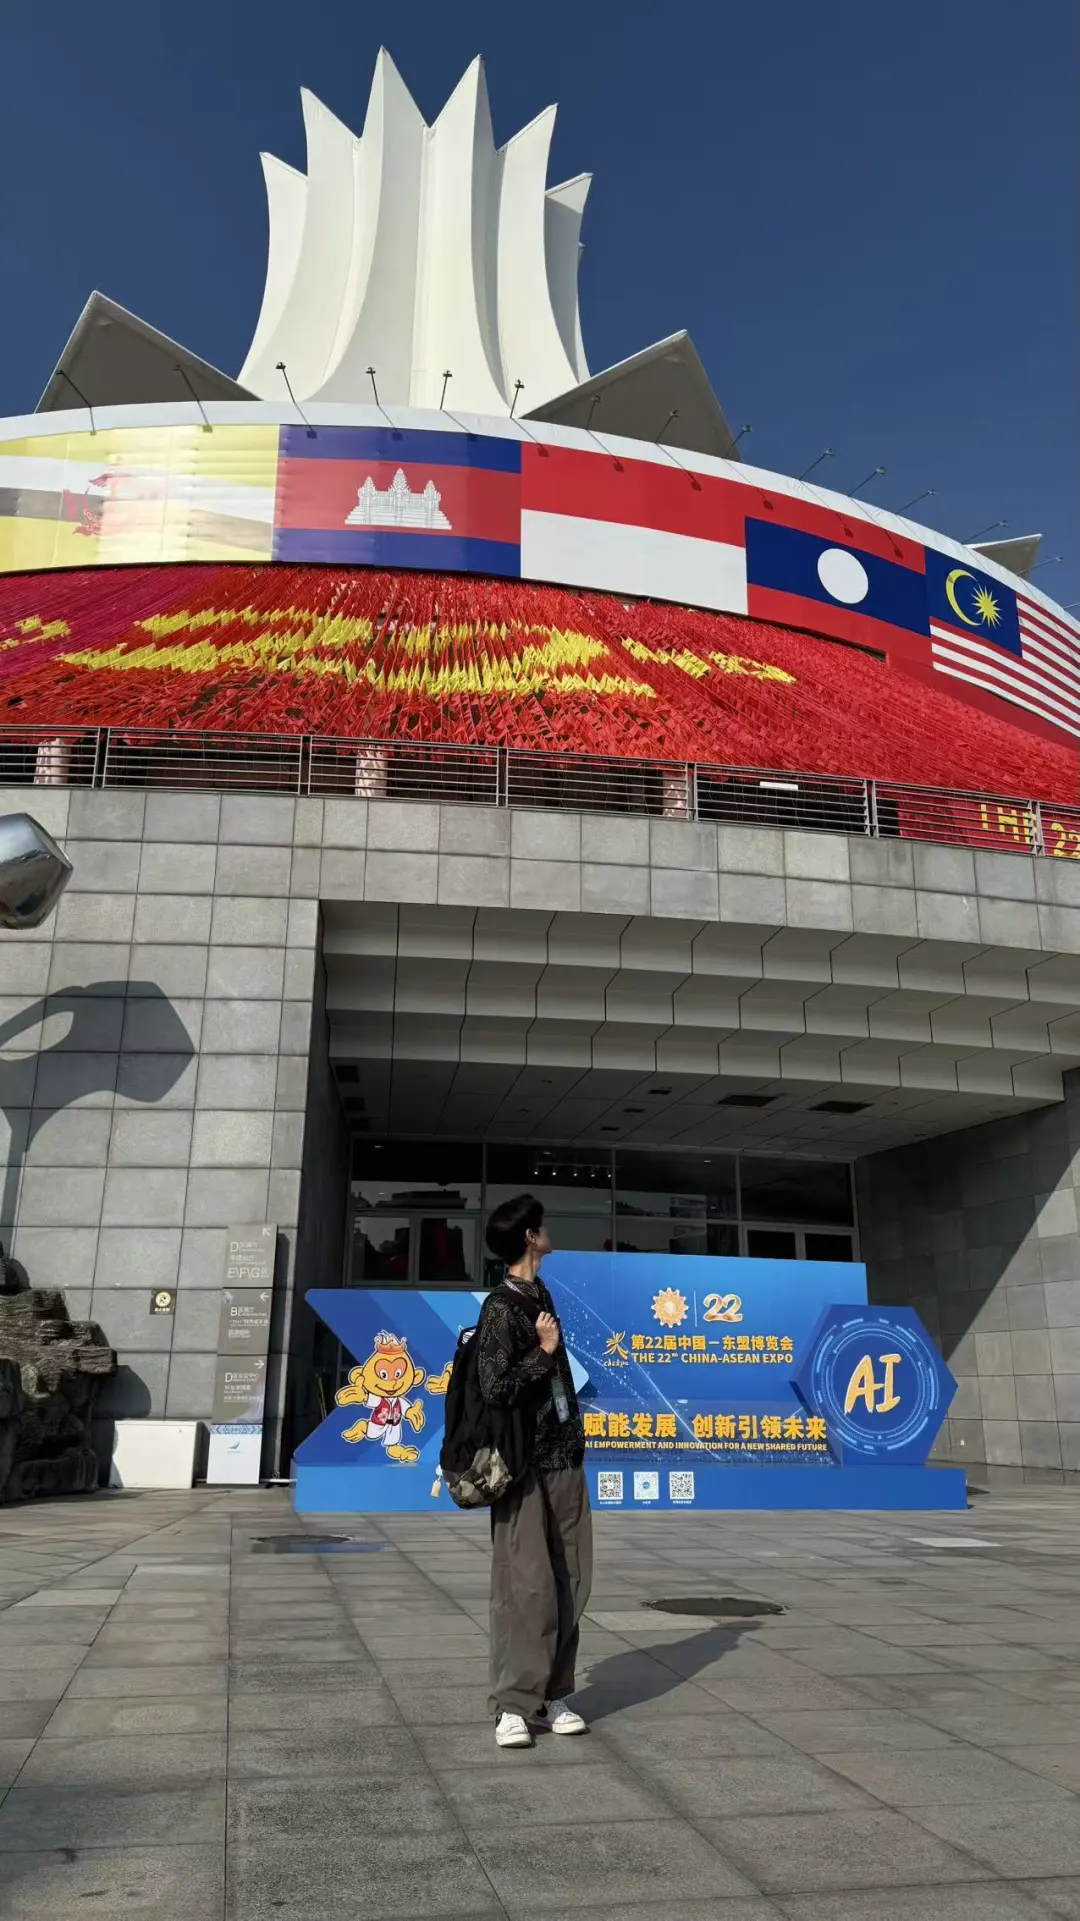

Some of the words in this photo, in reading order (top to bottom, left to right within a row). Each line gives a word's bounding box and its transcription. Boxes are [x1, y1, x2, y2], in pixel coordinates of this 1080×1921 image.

[703, 1293, 743, 1323] 22
[632, 1353, 655, 1363] THE
[681, 1353, 760, 1364] CHINA-ASEAN
[763, 1353, 794, 1364] EXPO
[844, 1353, 902, 1414] AI
[583, 1412, 677, 1438] 赋能发展
[692, 1413, 827, 1440] 创新引领未来
[585, 1441, 593, 1449] AI
[594, 1441, 656, 1449] EMPOWERMENT
[657, 1441, 674, 1449] AND
[675, 1441, 723, 1450] INNOVATION
[724, 1442, 740, 1450] FOR
[741, 1442, 747, 1450] A
[747, 1442, 765, 1450] NEW
[766, 1442, 796, 1450] SHARED
[797, 1443, 828, 1451] FUTURE
